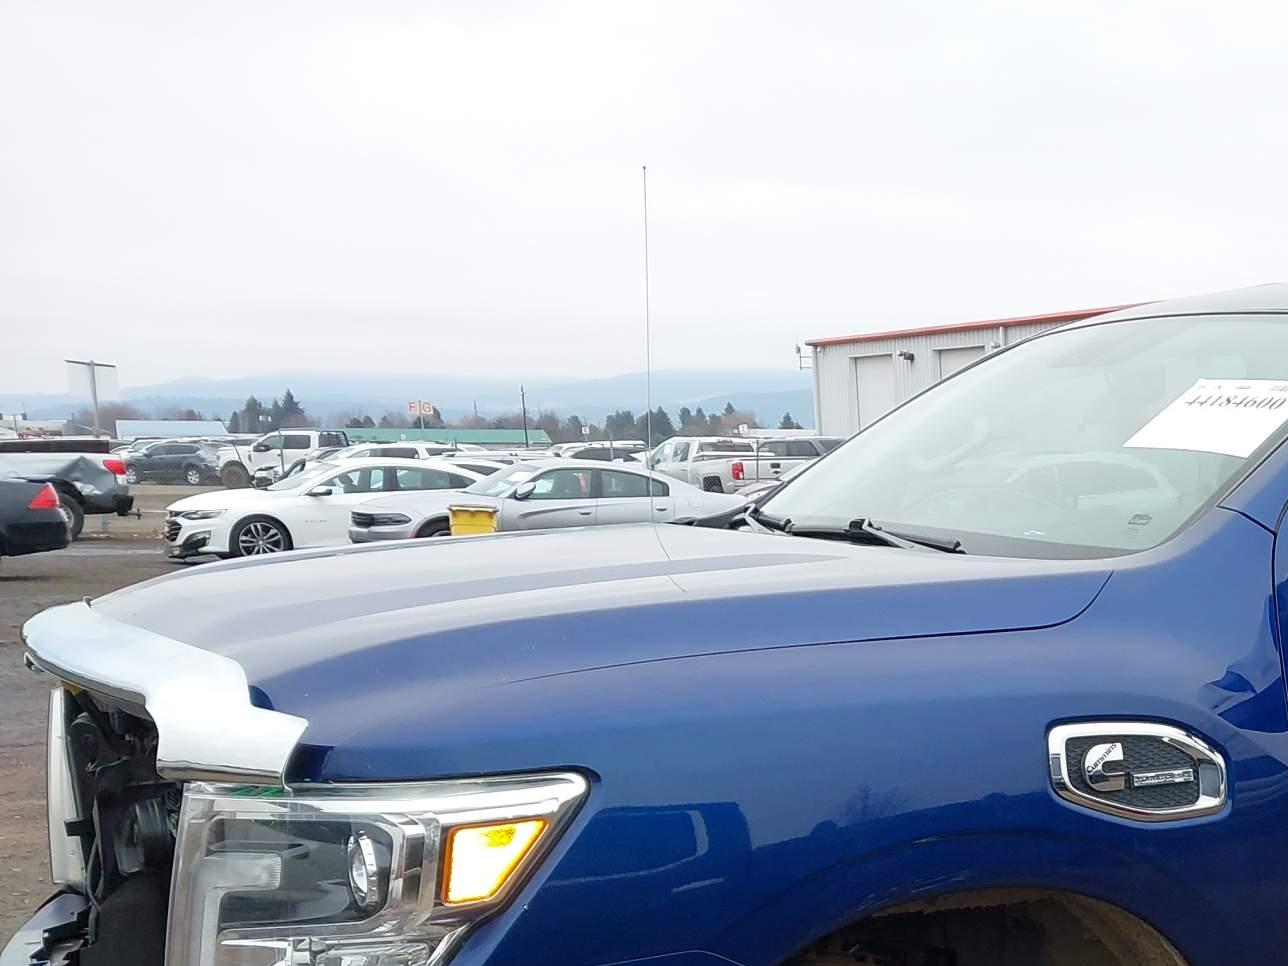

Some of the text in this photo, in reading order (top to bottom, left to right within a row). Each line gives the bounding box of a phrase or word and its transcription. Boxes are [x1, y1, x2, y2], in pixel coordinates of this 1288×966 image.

[422, 401, 432, 412] G
[1184, 393, 1288, 411] 44184600
[1086, 743, 1118, 774] Cummins
